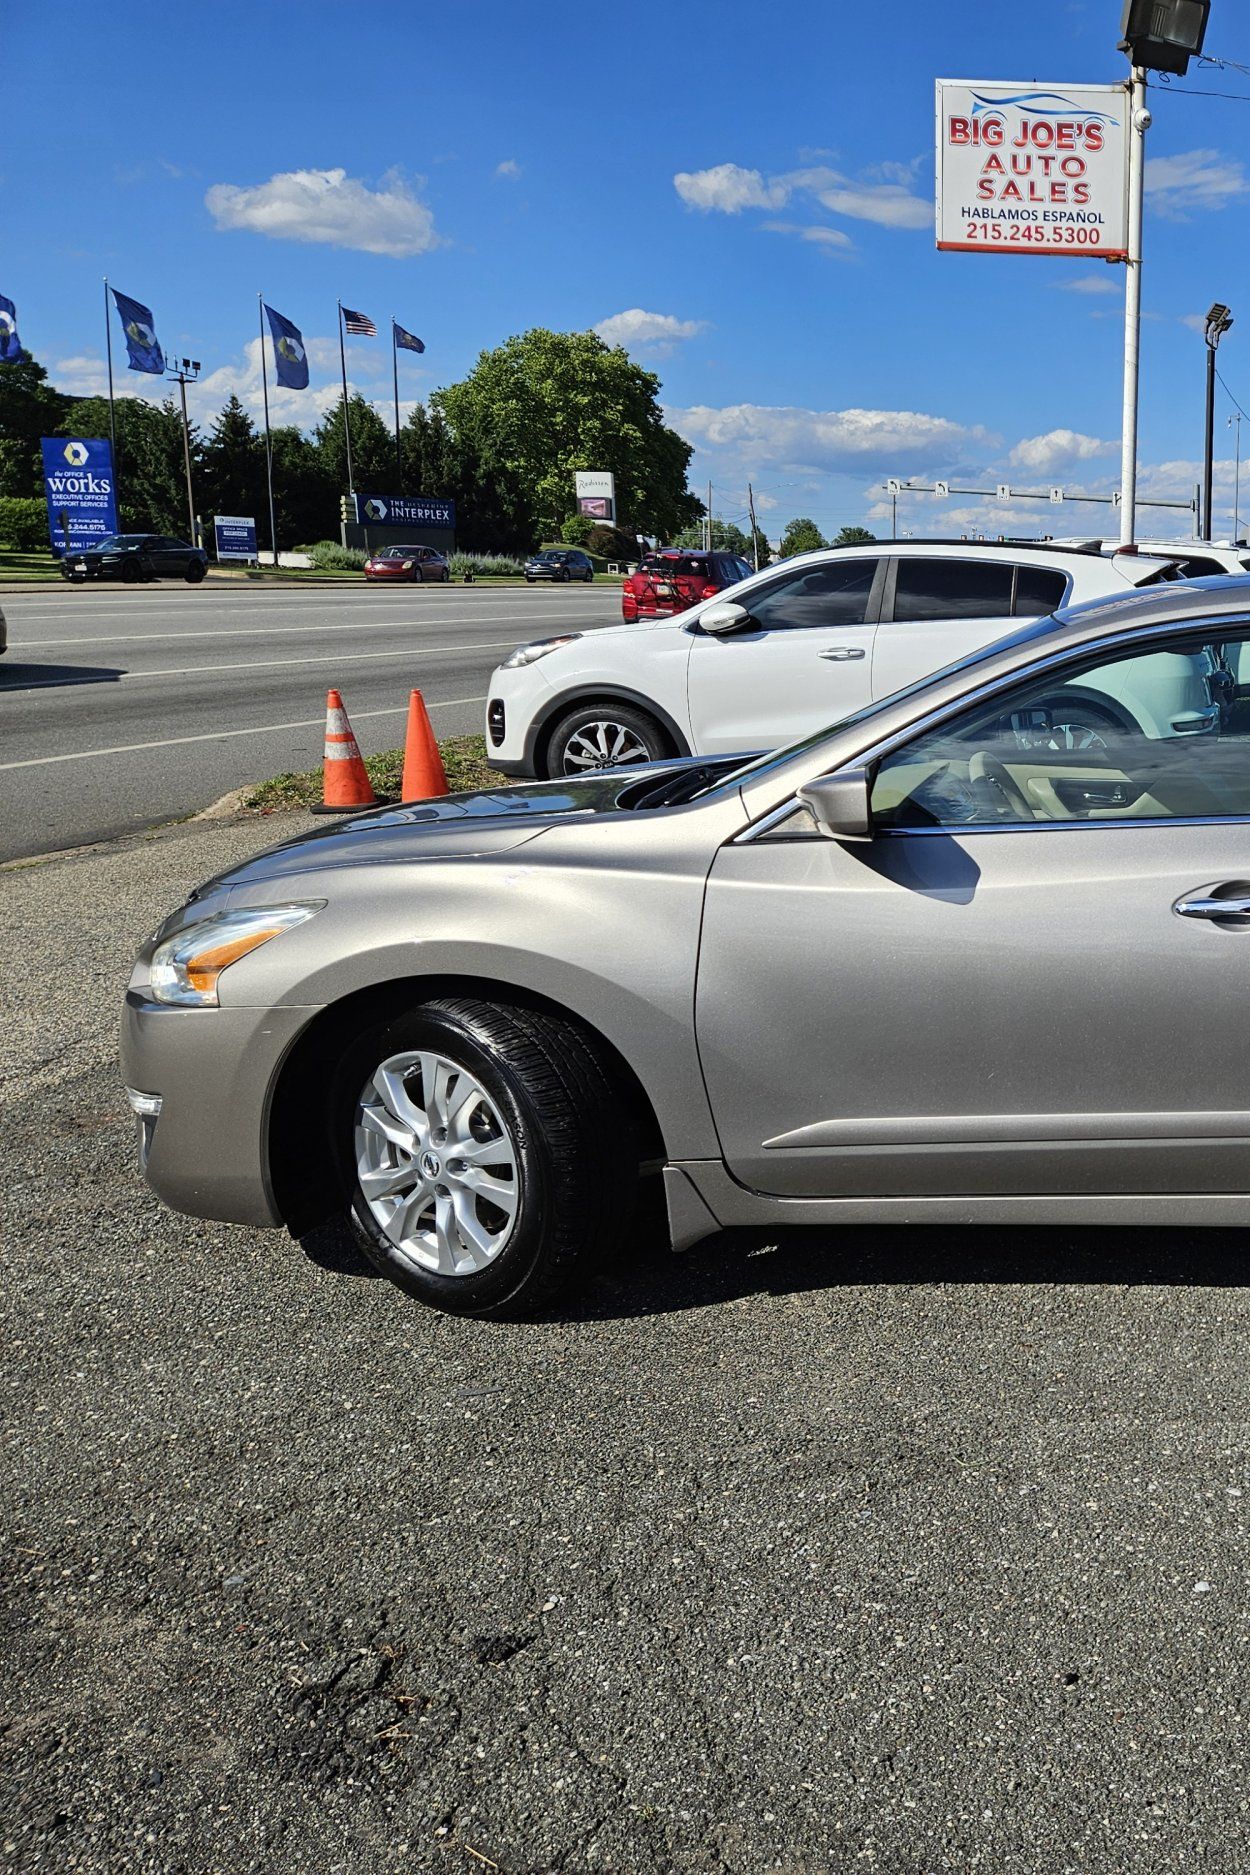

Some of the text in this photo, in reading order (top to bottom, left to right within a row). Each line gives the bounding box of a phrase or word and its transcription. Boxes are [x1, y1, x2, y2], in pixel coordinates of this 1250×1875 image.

[950, 116, 1105, 151] BIG JOE'S
[982, 153, 1087, 177] AUTO
[976, 178, 1091, 204] SALES
[961, 206, 1105, 224] HABLAMOS ESPAÑOL
[966, 222, 1100, 245] 215.245.5300
[47, 473, 110, 493] works
[391, 507, 450, 520] INTERPLEX
